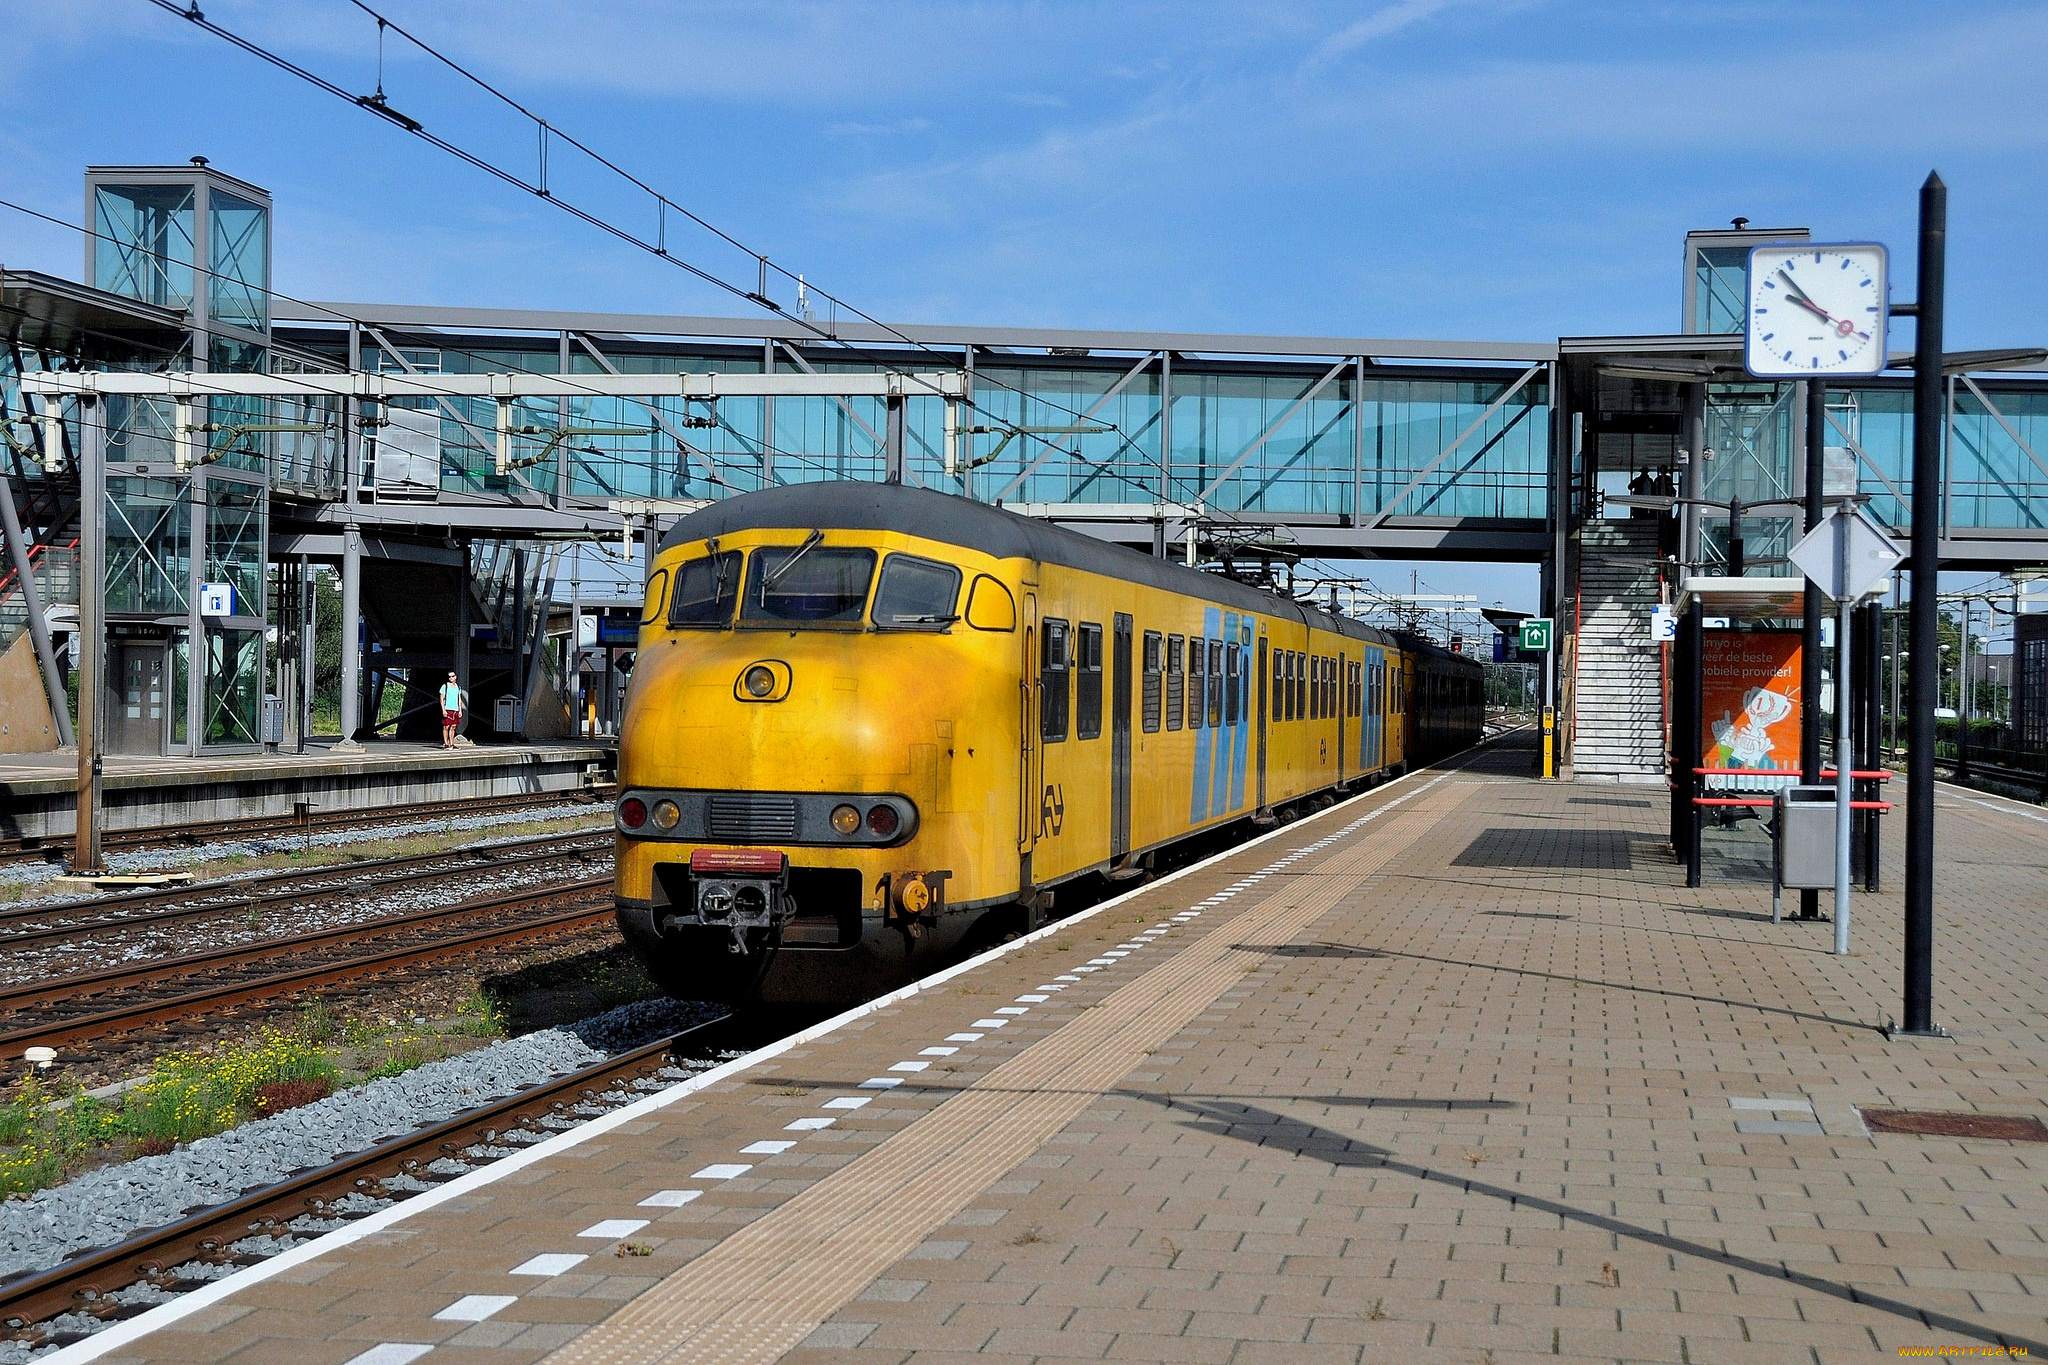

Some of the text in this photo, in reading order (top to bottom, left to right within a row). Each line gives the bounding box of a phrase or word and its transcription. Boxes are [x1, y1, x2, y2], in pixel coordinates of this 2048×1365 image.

[1662, 620, 1675, 637] 3
[1070, 626, 1077, 668] 2
[1702, 637, 1742, 651] imyo is
[1726, 651, 1740, 662] de
[1742, 651, 1773, 663] beste
[1742, 665, 1792, 679] provider!
